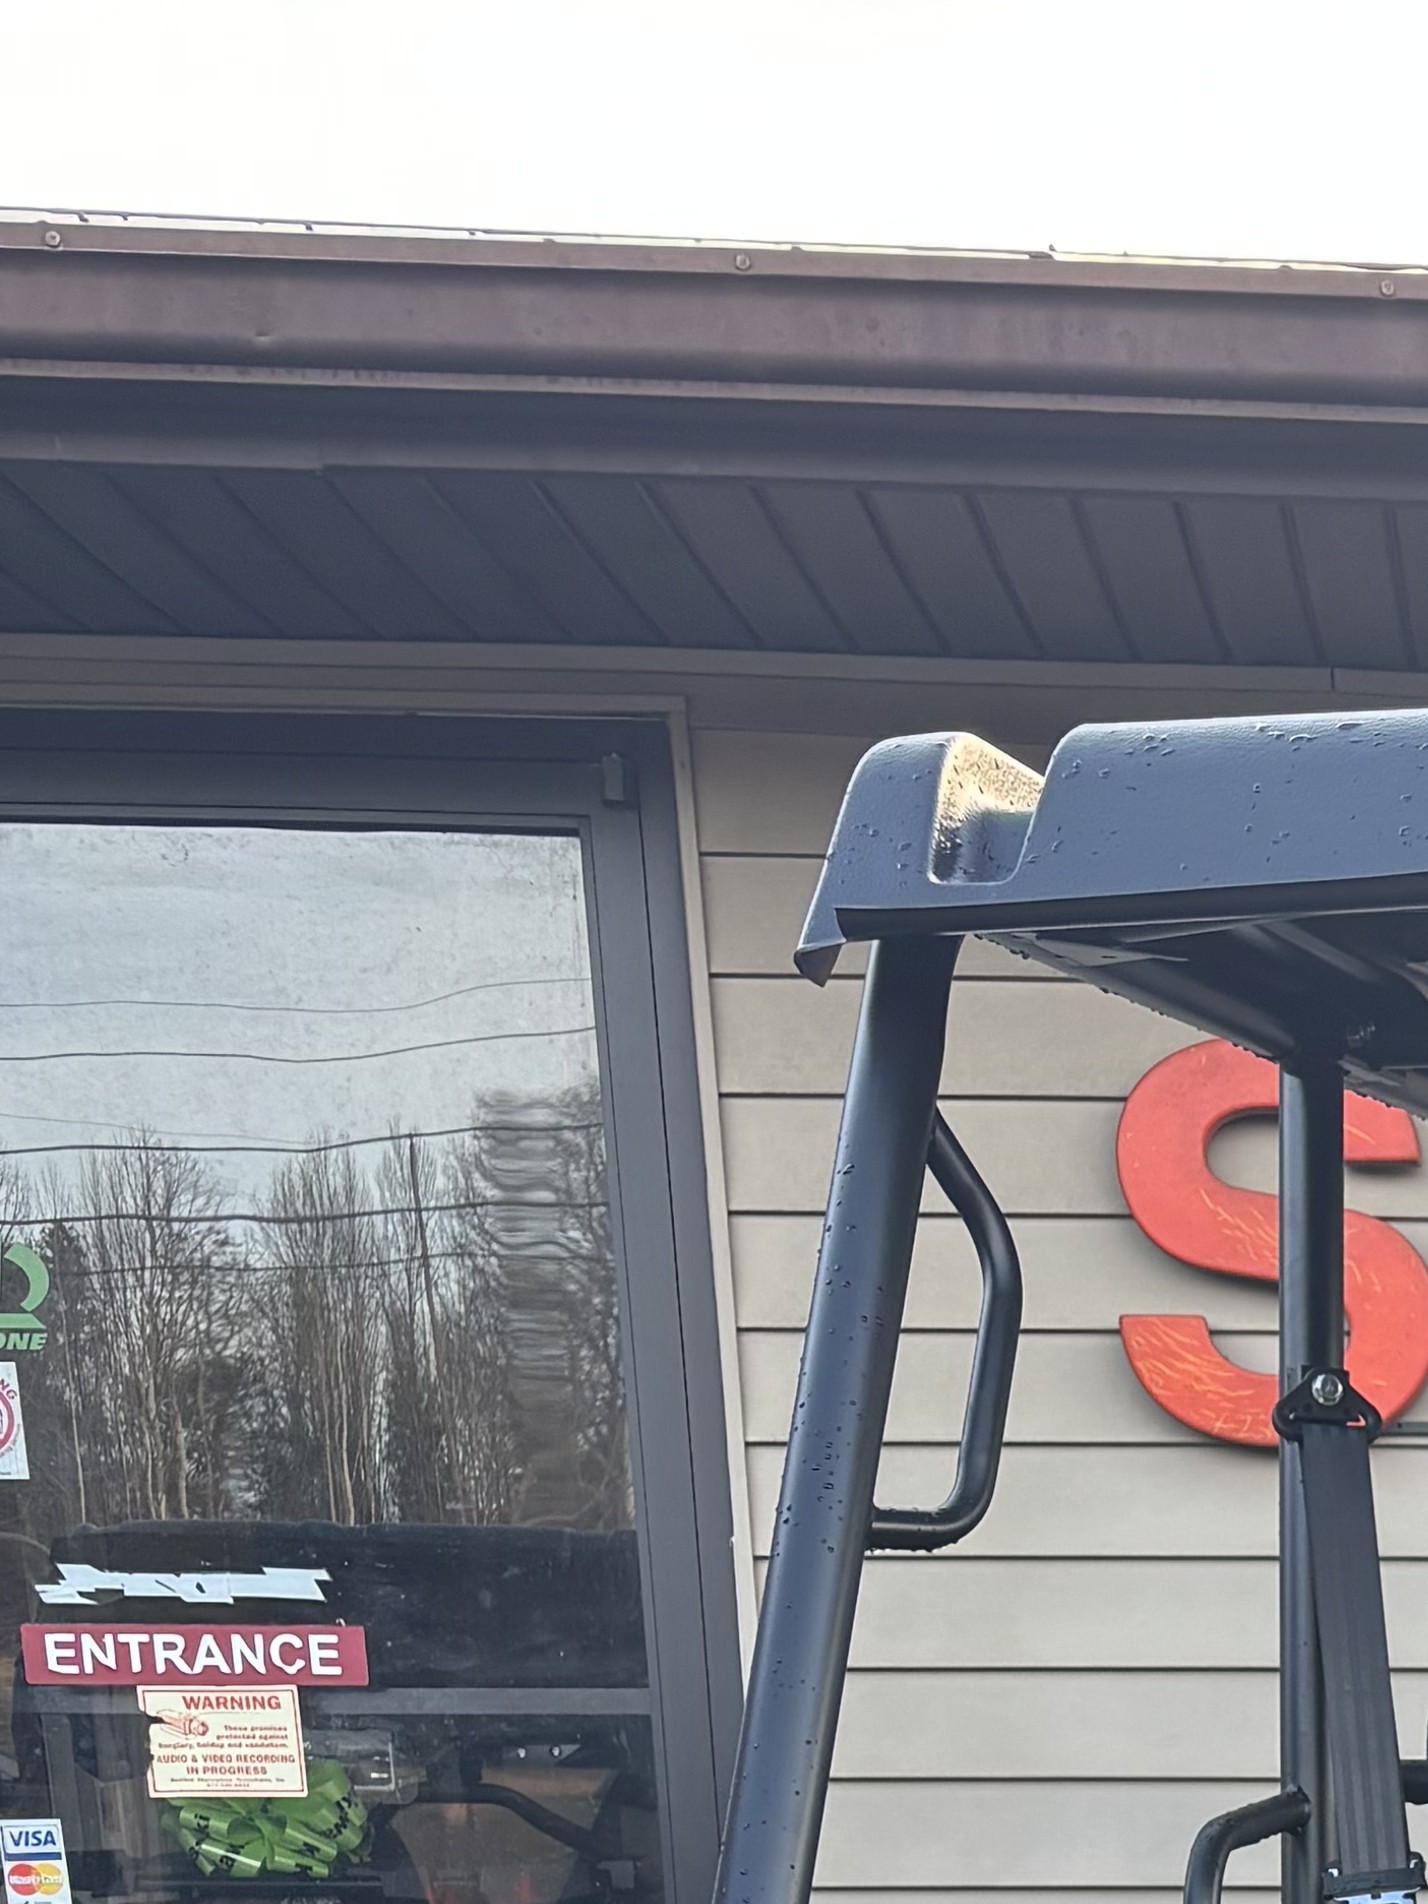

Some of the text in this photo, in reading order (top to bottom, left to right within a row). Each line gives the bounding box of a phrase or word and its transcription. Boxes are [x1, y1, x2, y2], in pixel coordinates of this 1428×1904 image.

[44, 1633, 343, 1675] ENTRANCE
[182, 1695, 281, 1711] WARNING
[156, 1754, 296, 1764] AUDIO & VIDEO RECORDING
[186, 1766, 268, 1775] IN PROGRESS
[9, 1830, 57, 1847] VISA
